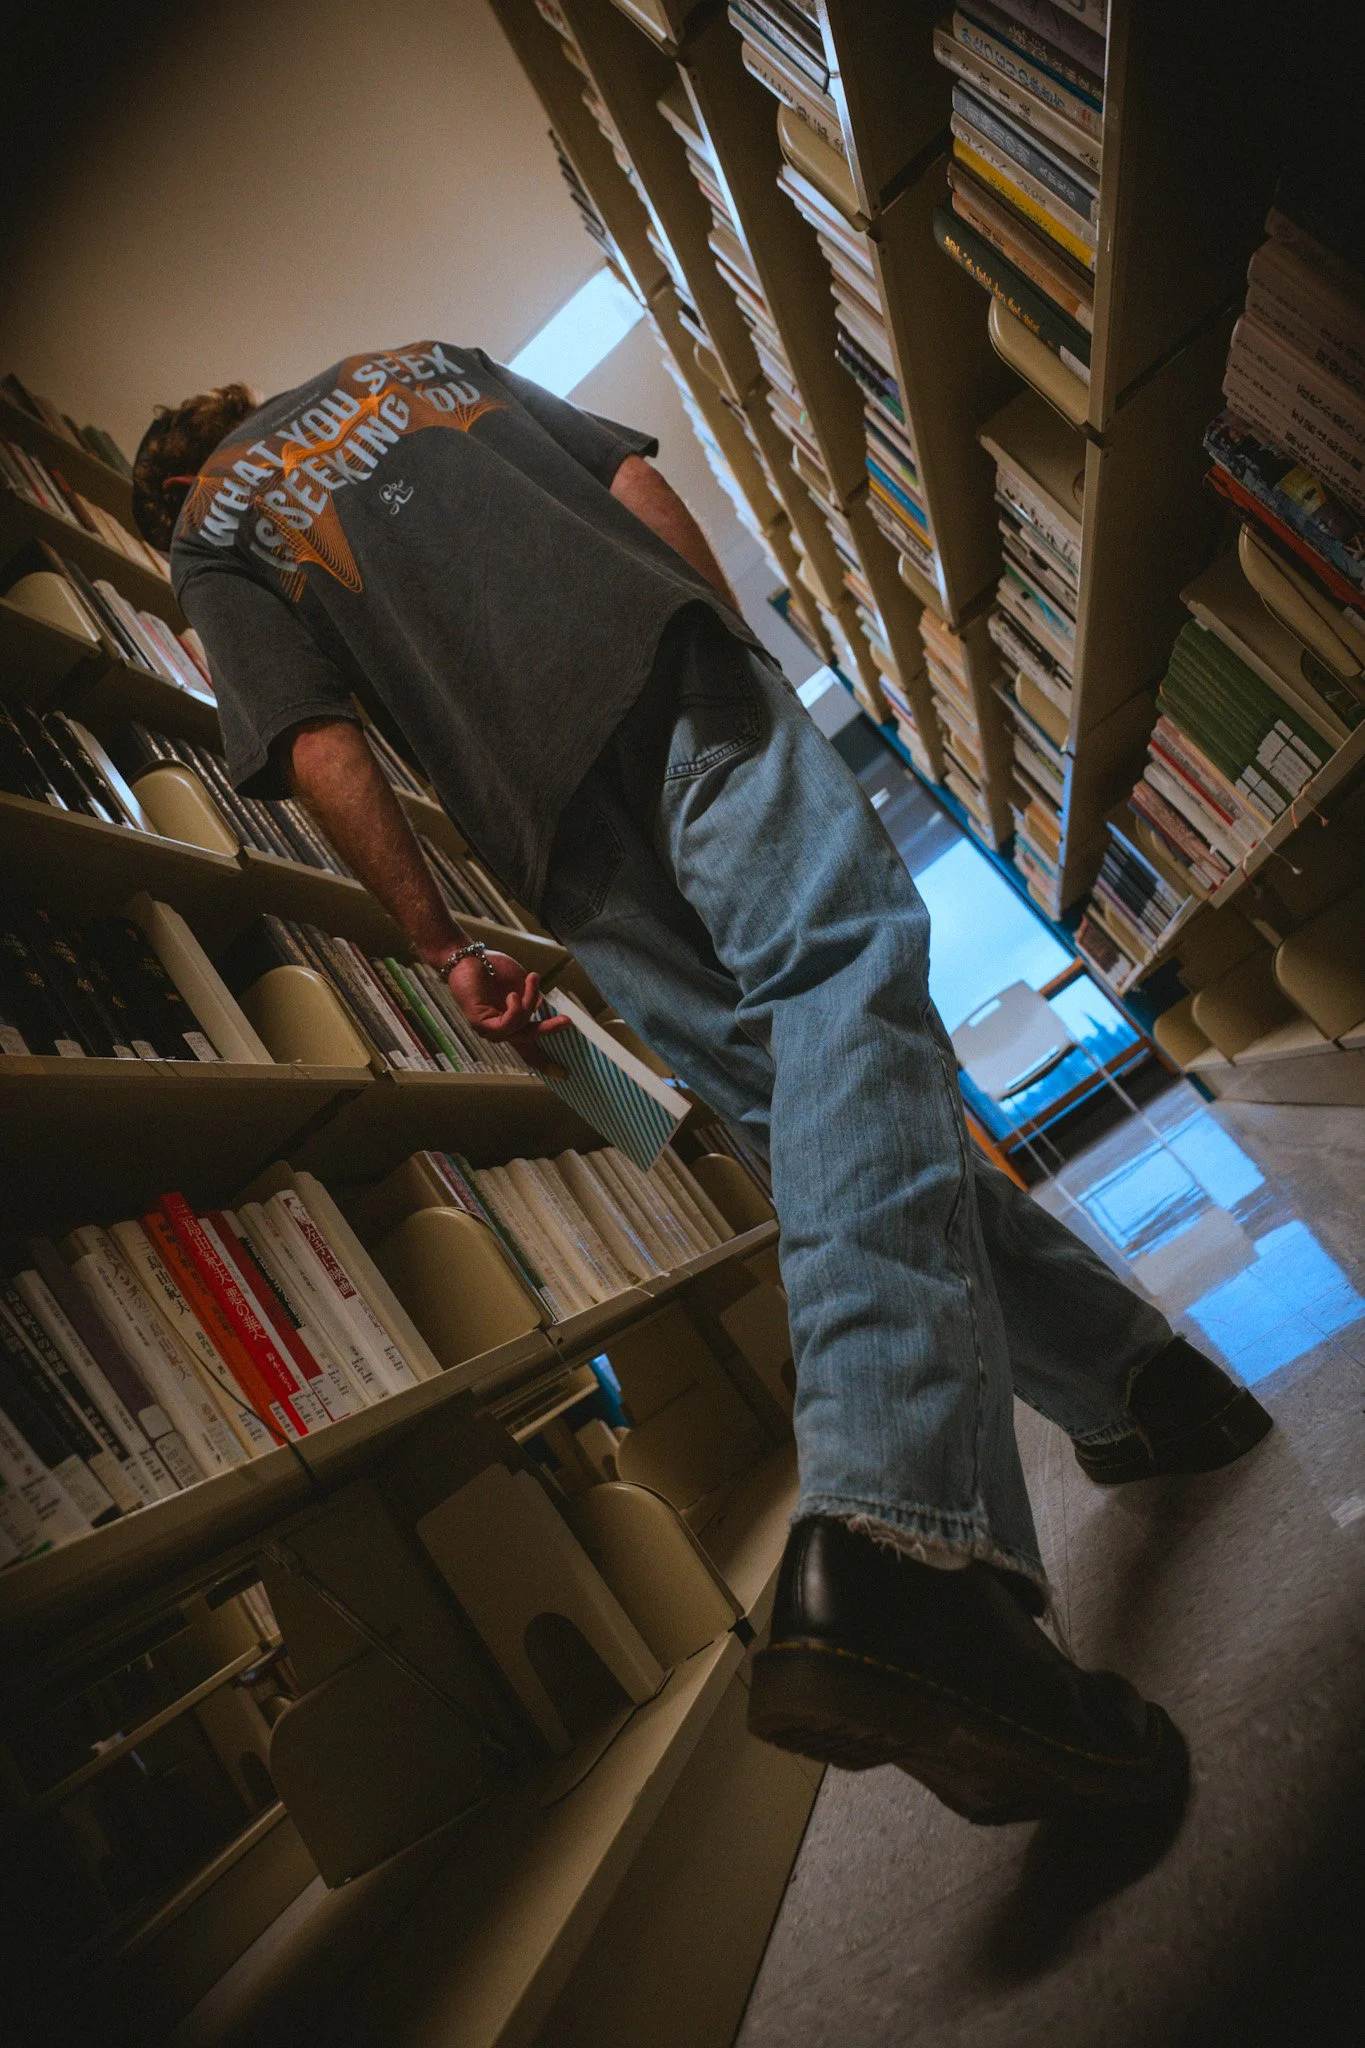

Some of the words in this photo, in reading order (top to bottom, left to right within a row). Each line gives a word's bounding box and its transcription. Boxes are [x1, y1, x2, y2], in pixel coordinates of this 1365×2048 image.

[200, 440, 286, 547] WHAT
[275, 388, 361, 450] YOU
[352, 344, 466, 396] SEEK
[264, 394, 410, 530] SEEKING
[416, 381, 481, 413] OU
